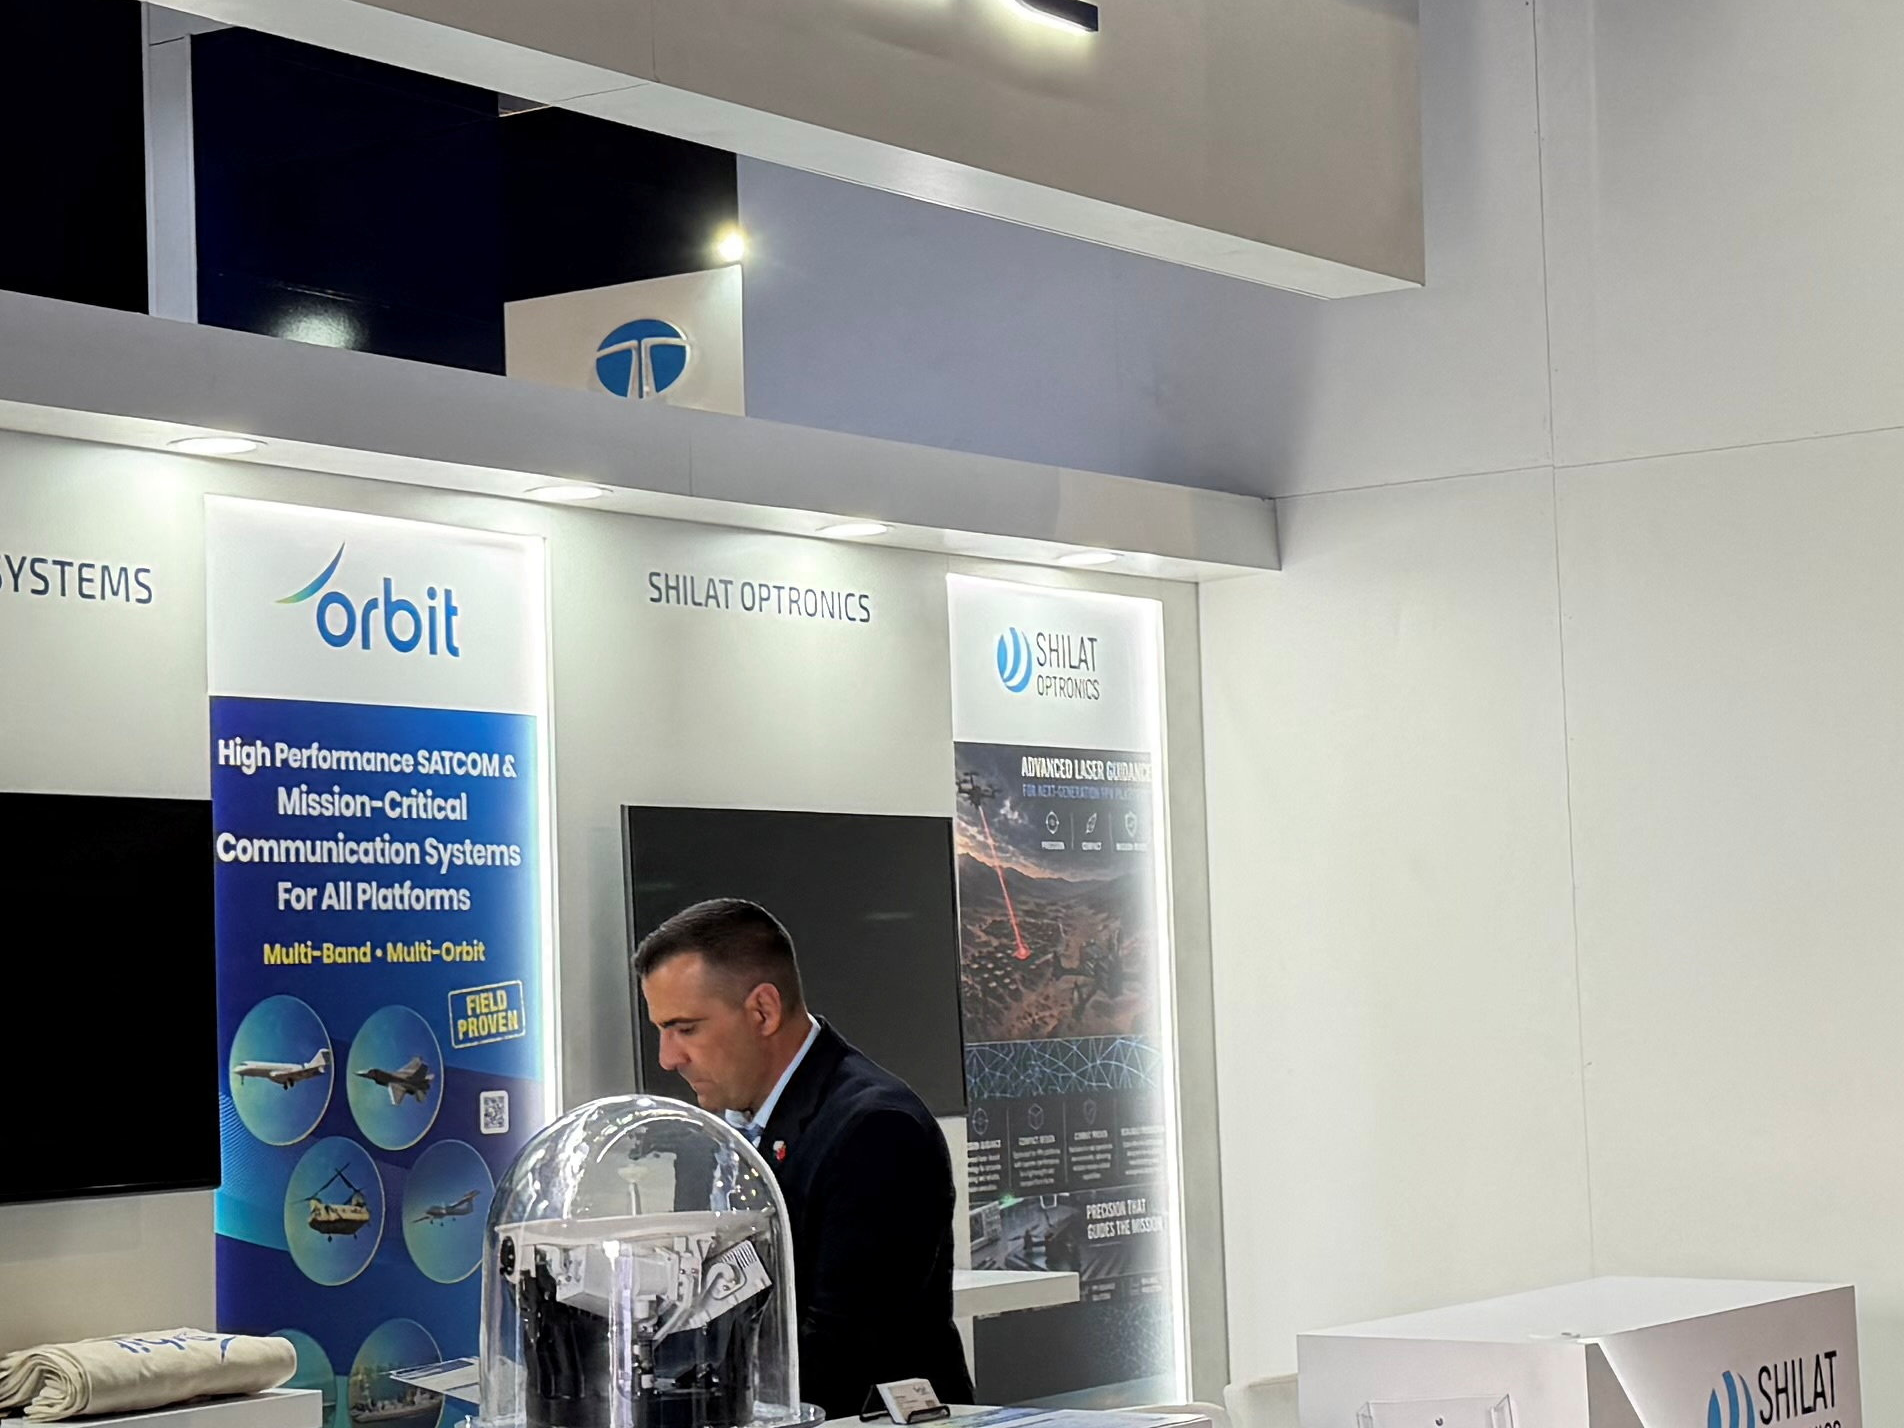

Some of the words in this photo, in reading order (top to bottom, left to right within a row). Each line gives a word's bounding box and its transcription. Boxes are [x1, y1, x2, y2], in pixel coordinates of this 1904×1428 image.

[648, 571, 733, 610] SHILAT
[741, 580, 871, 624] OPTRONICS
[316, 576, 460, 658] orbit
[1036, 631, 1098, 673] SHILAT
[1036, 675, 1100, 701] OPTRONICS
[217, 738, 271, 776] High
[275, 742, 414, 774] Performance
[417, 750, 500, 778] SATCOM
[502, 754, 517, 778] &
[1021, 756, 1073, 779] ADVANCED
[1074, 759, 1105, 780] LASER
[277, 786, 467, 822] Mission-Critical
[216, 832, 420, 865] Communication
[425, 837, 522, 874] Systems
[277, 881, 317, 911] For
[321, 880, 353, 911] All
[356, 881, 472, 912] Platforms
[263, 942, 371, 965] Multi-Band
[386, 940, 486, 965] Multi-Orbit
[466, 989, 508, 1016] FIELD
[457, 1008, 519, 1040] PROVEN
[1758, 1349, 1838, 1425] SHILAT
